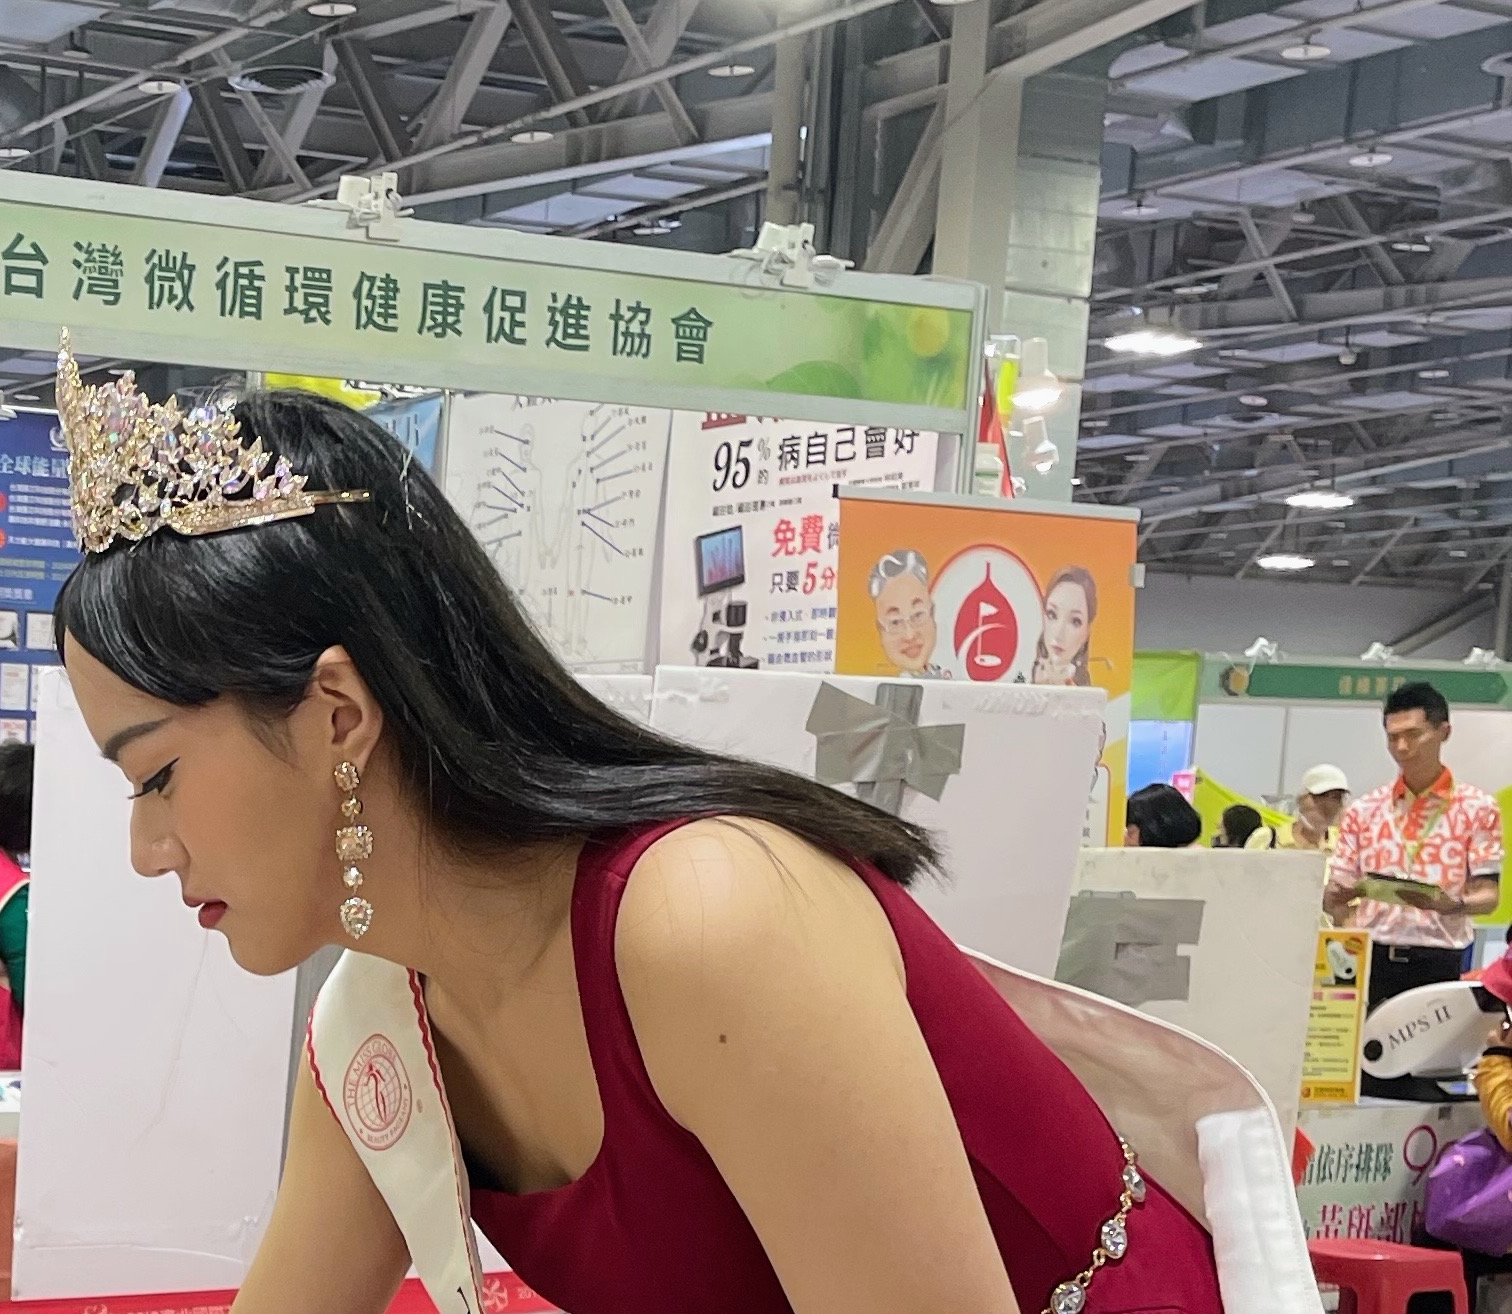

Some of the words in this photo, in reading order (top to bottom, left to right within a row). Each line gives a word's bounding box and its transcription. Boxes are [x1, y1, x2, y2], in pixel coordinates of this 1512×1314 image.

[0, 232, 715, 365] 台灣微循環健康促進協會
[778, 426, 920, 471] 病自己會好
[1388, 1015, 1432, 1050] MPS
[1303, 1142, 1393, 1186] 依序排隊
